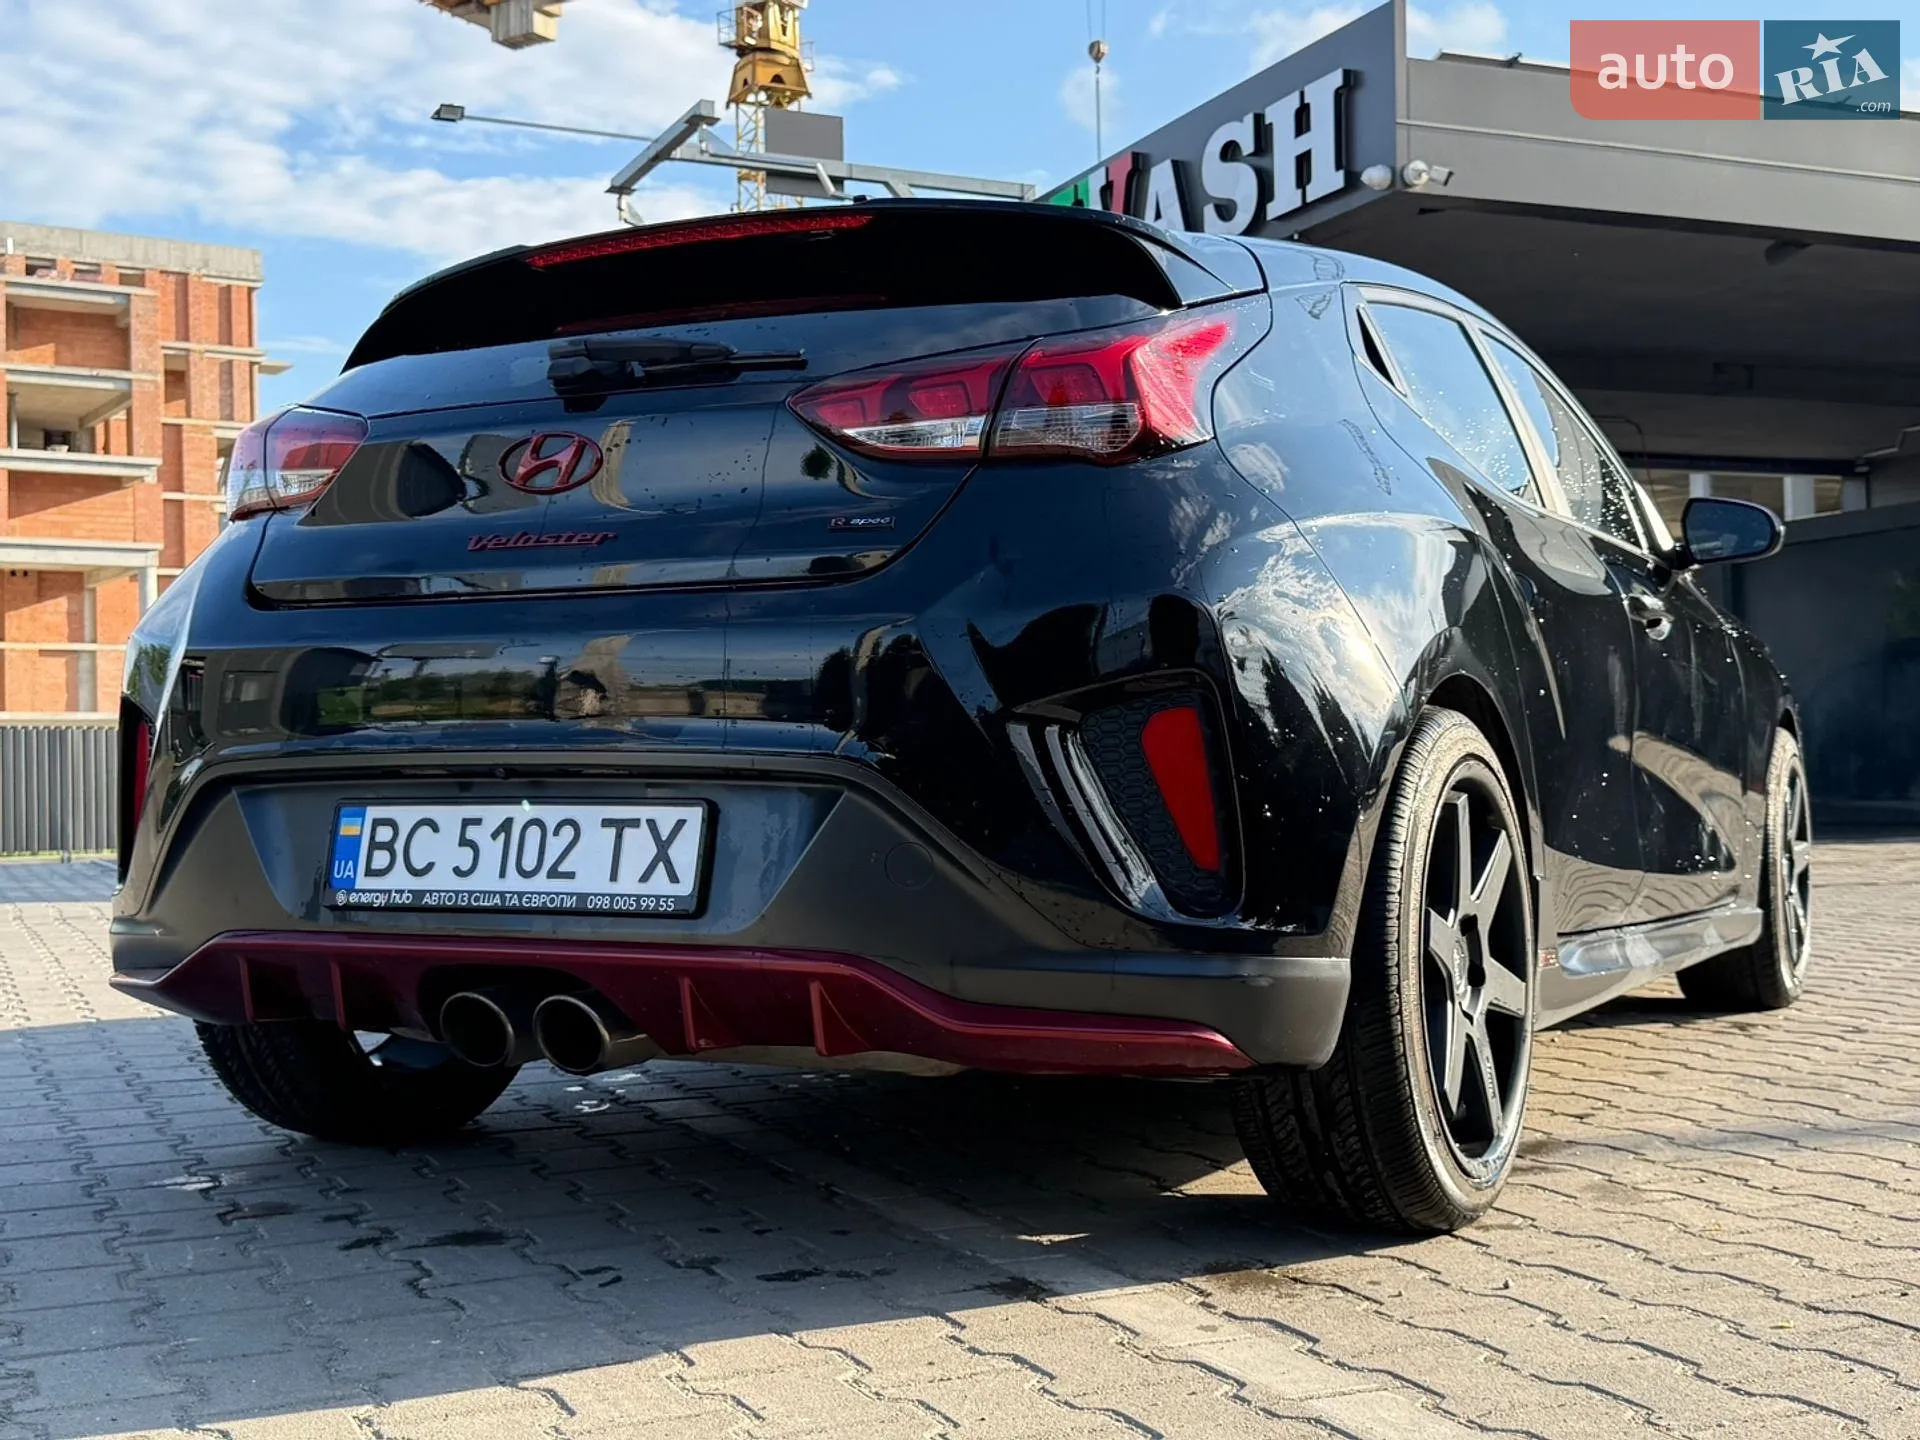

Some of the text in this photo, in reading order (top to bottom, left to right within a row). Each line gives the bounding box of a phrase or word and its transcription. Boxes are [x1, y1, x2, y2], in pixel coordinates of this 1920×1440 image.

[467, 531, 617, 551] Veloster
[364, 817, 687, 885] BC 5102 TX
[334, 860, 354, 879] UA
[350, 889, 413, 907] energy hub
[421, 892, 456, 906] АВТО
[471, 892, 500, 906] США
[505, 893, 520, 907] ТА
[522, 893, 577, 908] ЄВРОПИ
[587, 896, 675, 912] 098 005 99 55
